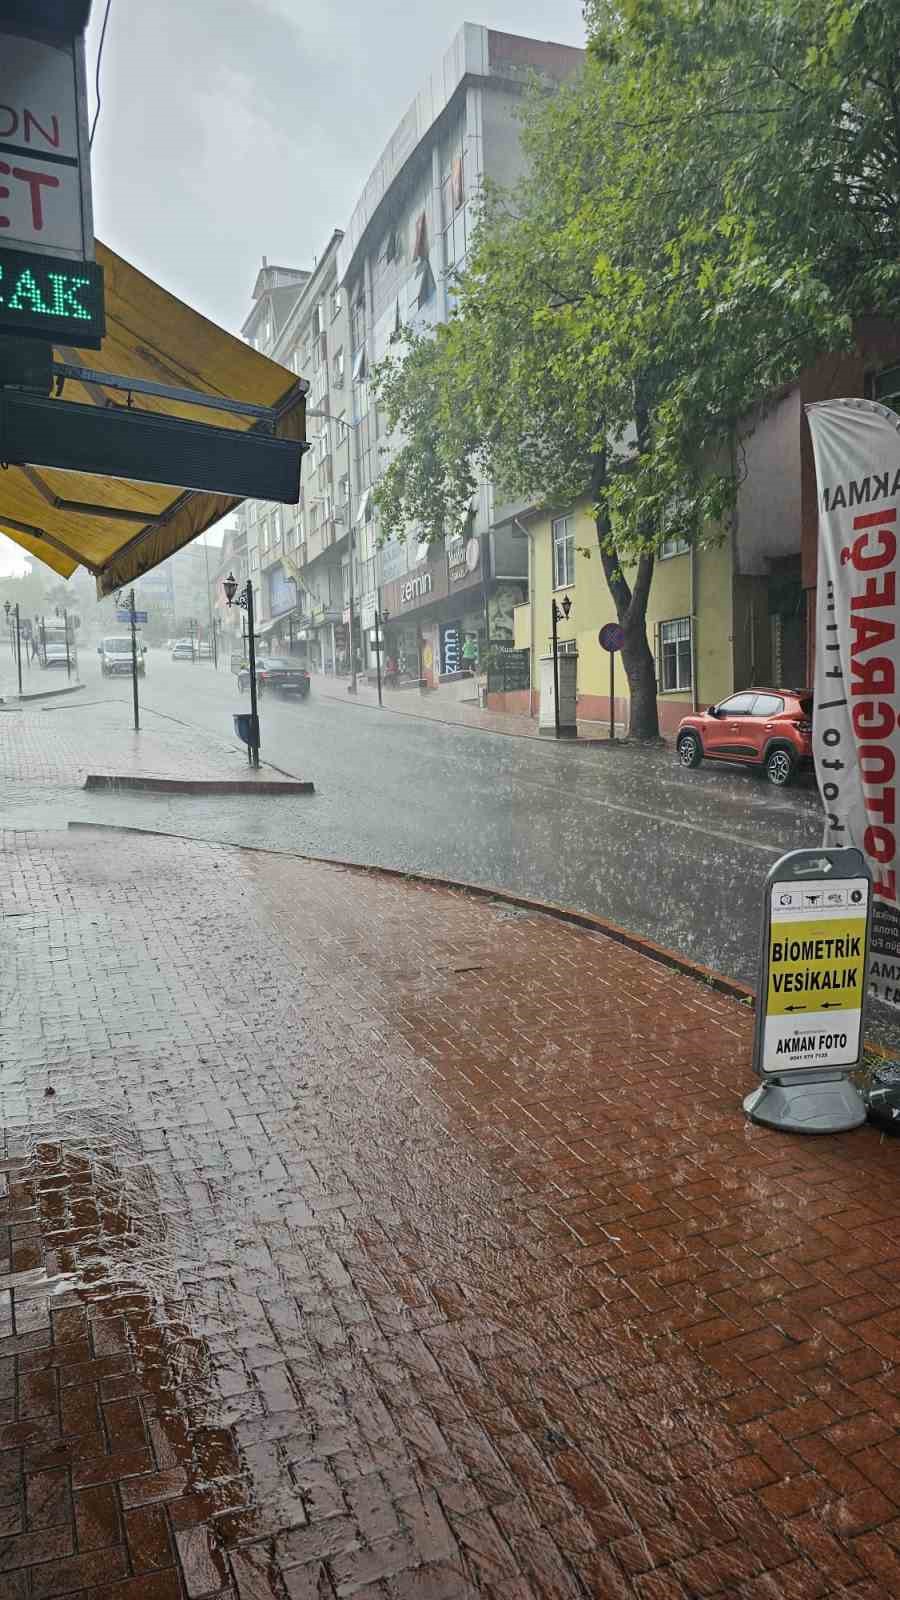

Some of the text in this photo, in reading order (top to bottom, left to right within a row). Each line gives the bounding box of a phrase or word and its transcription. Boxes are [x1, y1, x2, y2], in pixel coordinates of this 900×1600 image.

[0, 265, 92, 320] AK
[400, 574, 432, 602] zemin
[772, 934, 860, 962] BİOMETRİK
[772, 968, 857, 993] VESİKALIK
[776, 1033, 847, 1055] AKMAN FOTO
